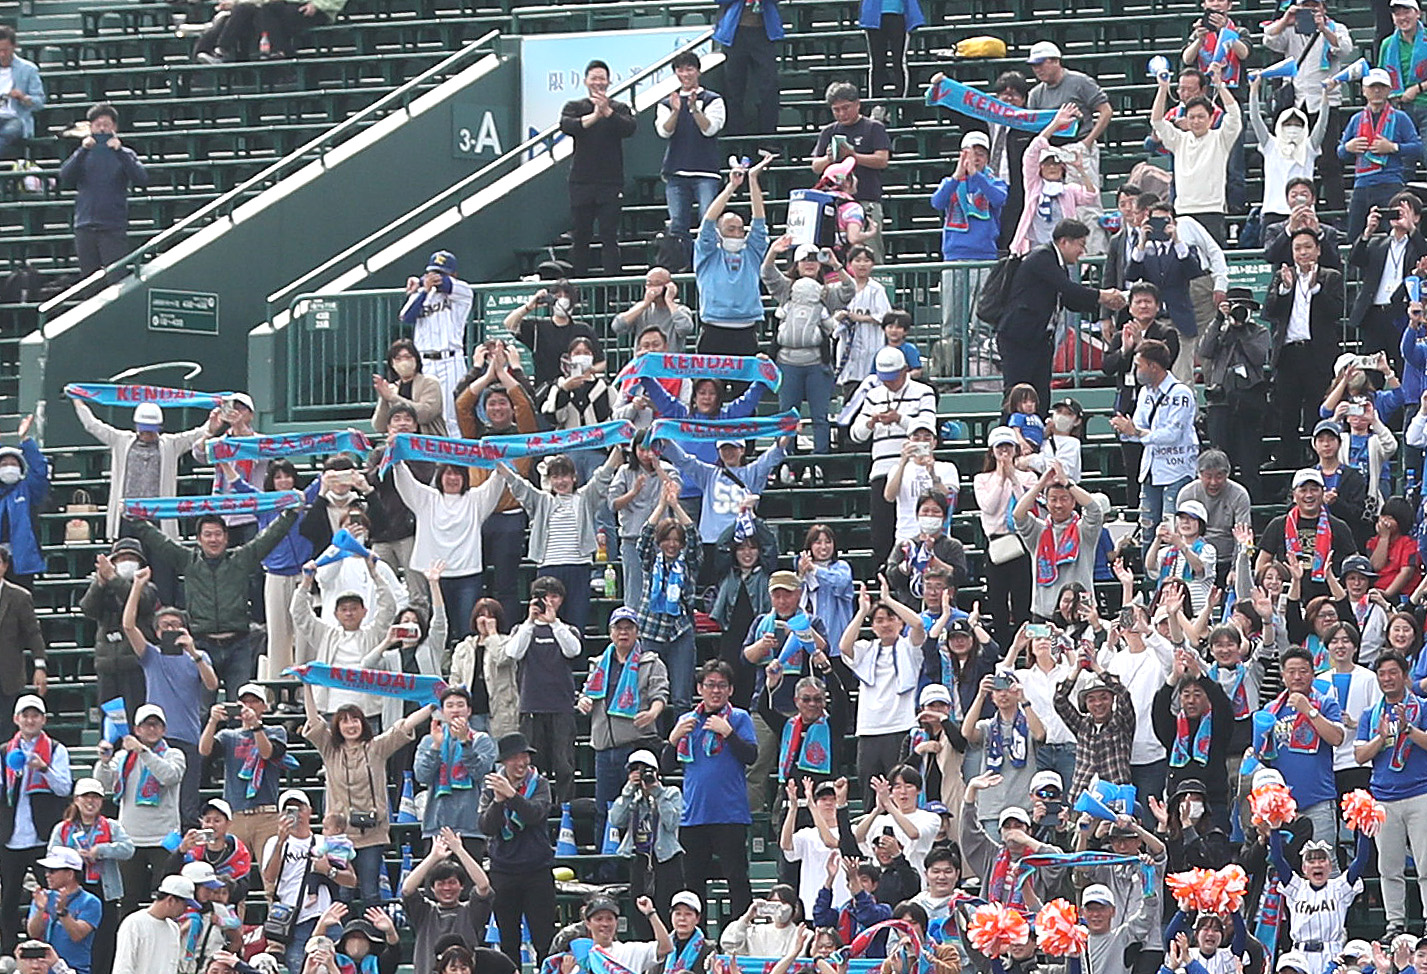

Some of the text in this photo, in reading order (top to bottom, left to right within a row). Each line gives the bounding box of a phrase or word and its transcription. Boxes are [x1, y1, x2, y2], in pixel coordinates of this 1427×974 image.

[963, 91, 1038, 124] KENDAI
[459, 111, 502, 155] 3-A
[663, 353, 744, 371] KENDAI
[329, 667, 416, 690] KENDAI
